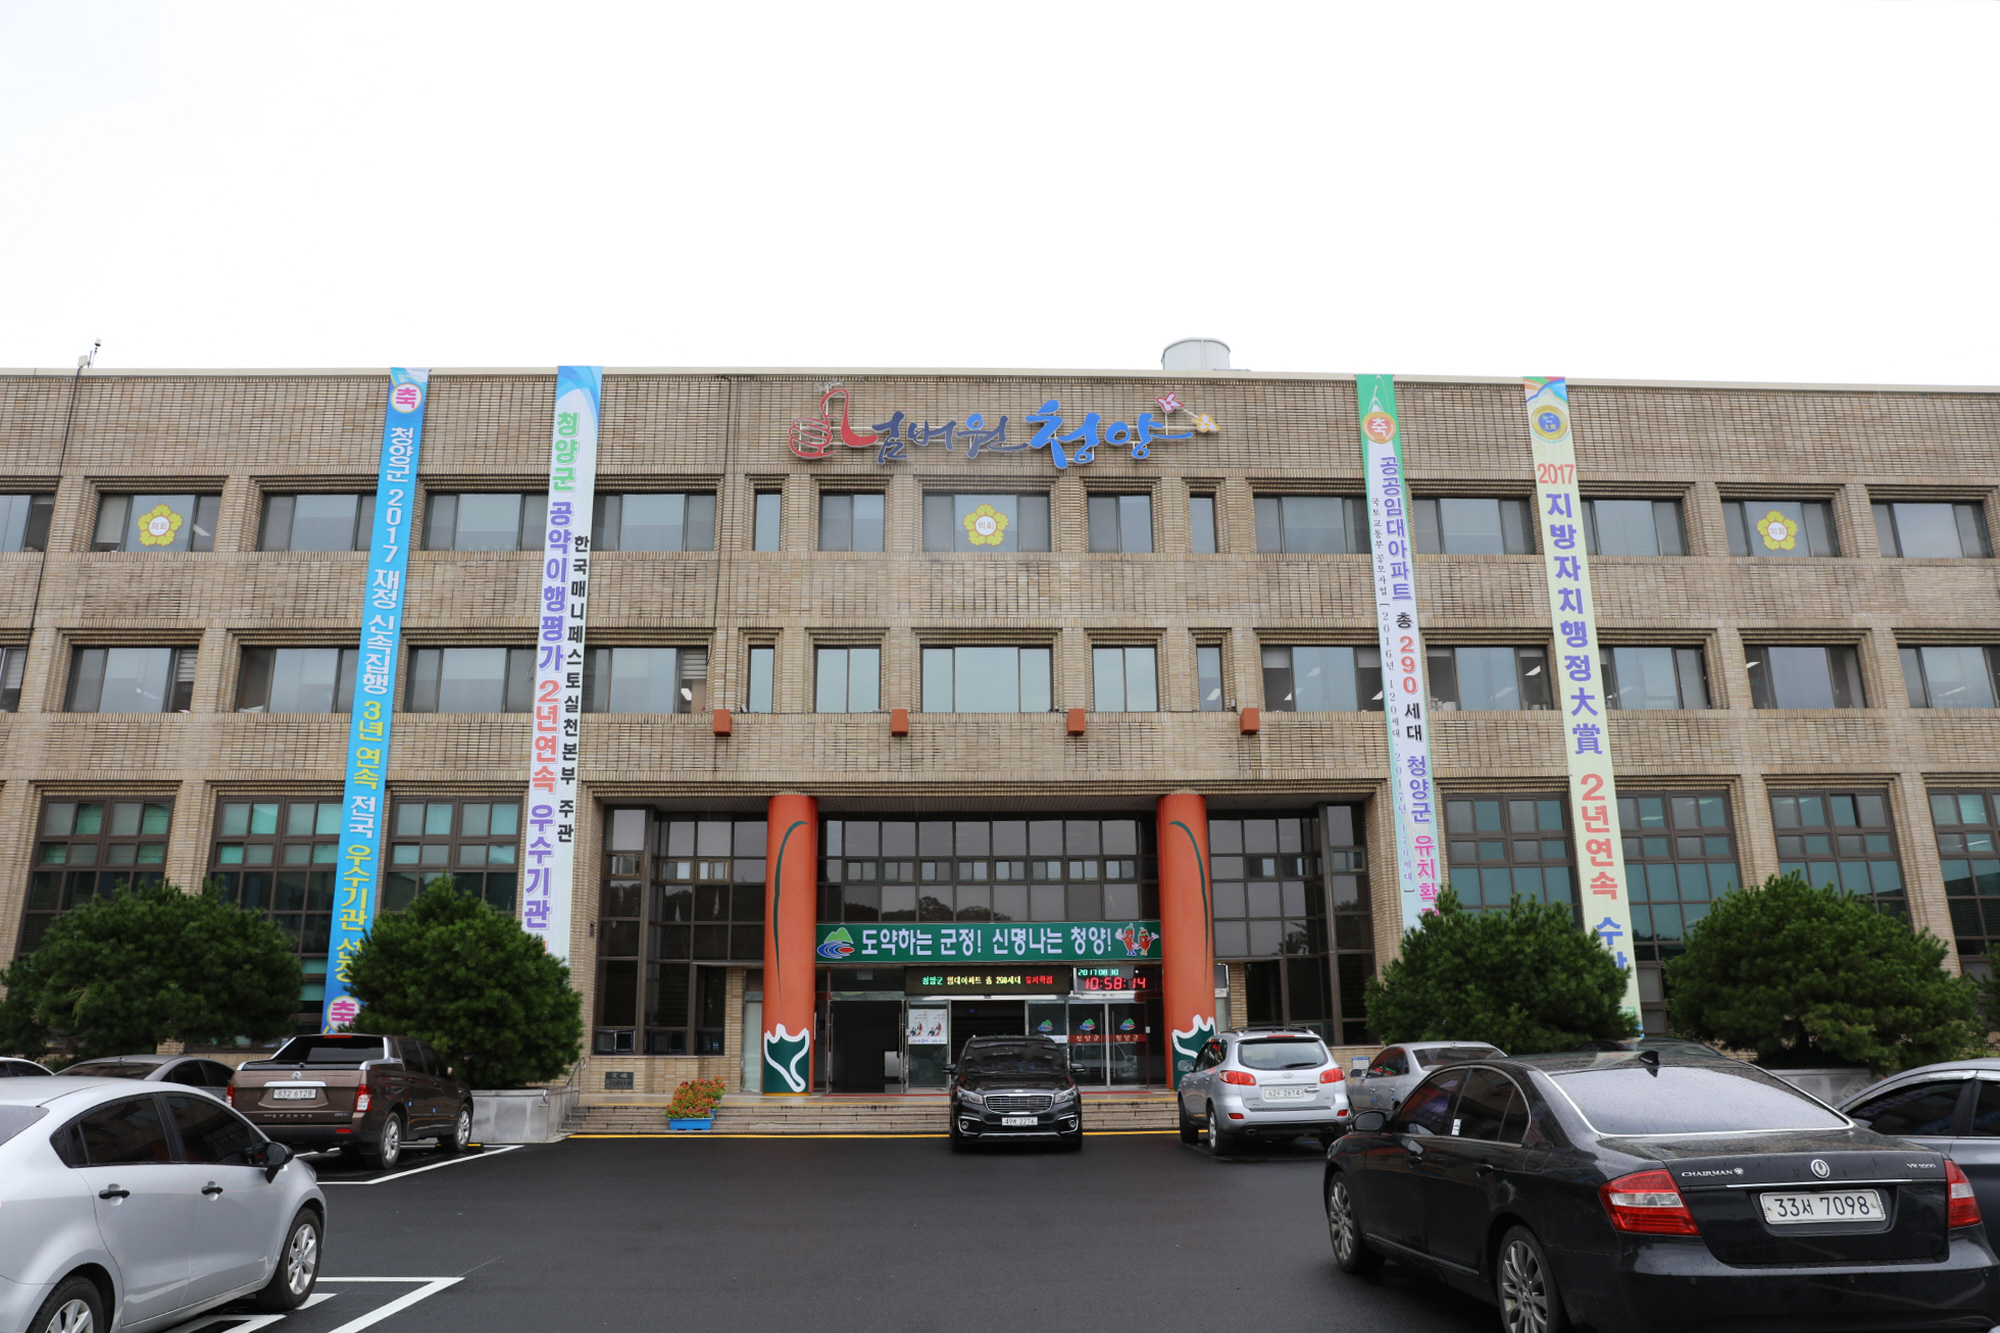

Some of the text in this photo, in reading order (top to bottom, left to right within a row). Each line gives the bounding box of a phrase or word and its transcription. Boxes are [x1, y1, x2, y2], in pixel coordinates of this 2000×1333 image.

[395, 387, 417, 408] 축
[1025, 399, 1194, 470] 청양
[1371, 418, 1388, 436] 축
[386, 427, 414, 483] 청양군
[1537, 463, 1575, 485] 2017
[382, 488, 405, 564] 2017
[1371, 498, 1384, 549] 국토교통부
[372, 569, 400, 610] 재정
[362, 614, 396, 695] 신속집행
[1380, 457, 1412, 601] 공공임대아파트
[1407, 755, 1432, 823] 청양군
[524, 411, 579, 929] 청양군 공약이행평가 2년연속 우수기관
[358, 701, 384, 742] 3년
[352, 747, 381, 790] 연속
[348, 795, 376, 839] 전국
[557, 800, 575, 843] 주관
[1580, 773, 1618, 900] 2년연속
[339, 845, 373, 932] 우수기관
[862, 926, 1112, 956] 도약하는 군정! 신명나는 청양!
[1681, 1169, 1733, 1177] CHAIRMAN
[1775, 1195, 1870, 1218] 33서 7098
